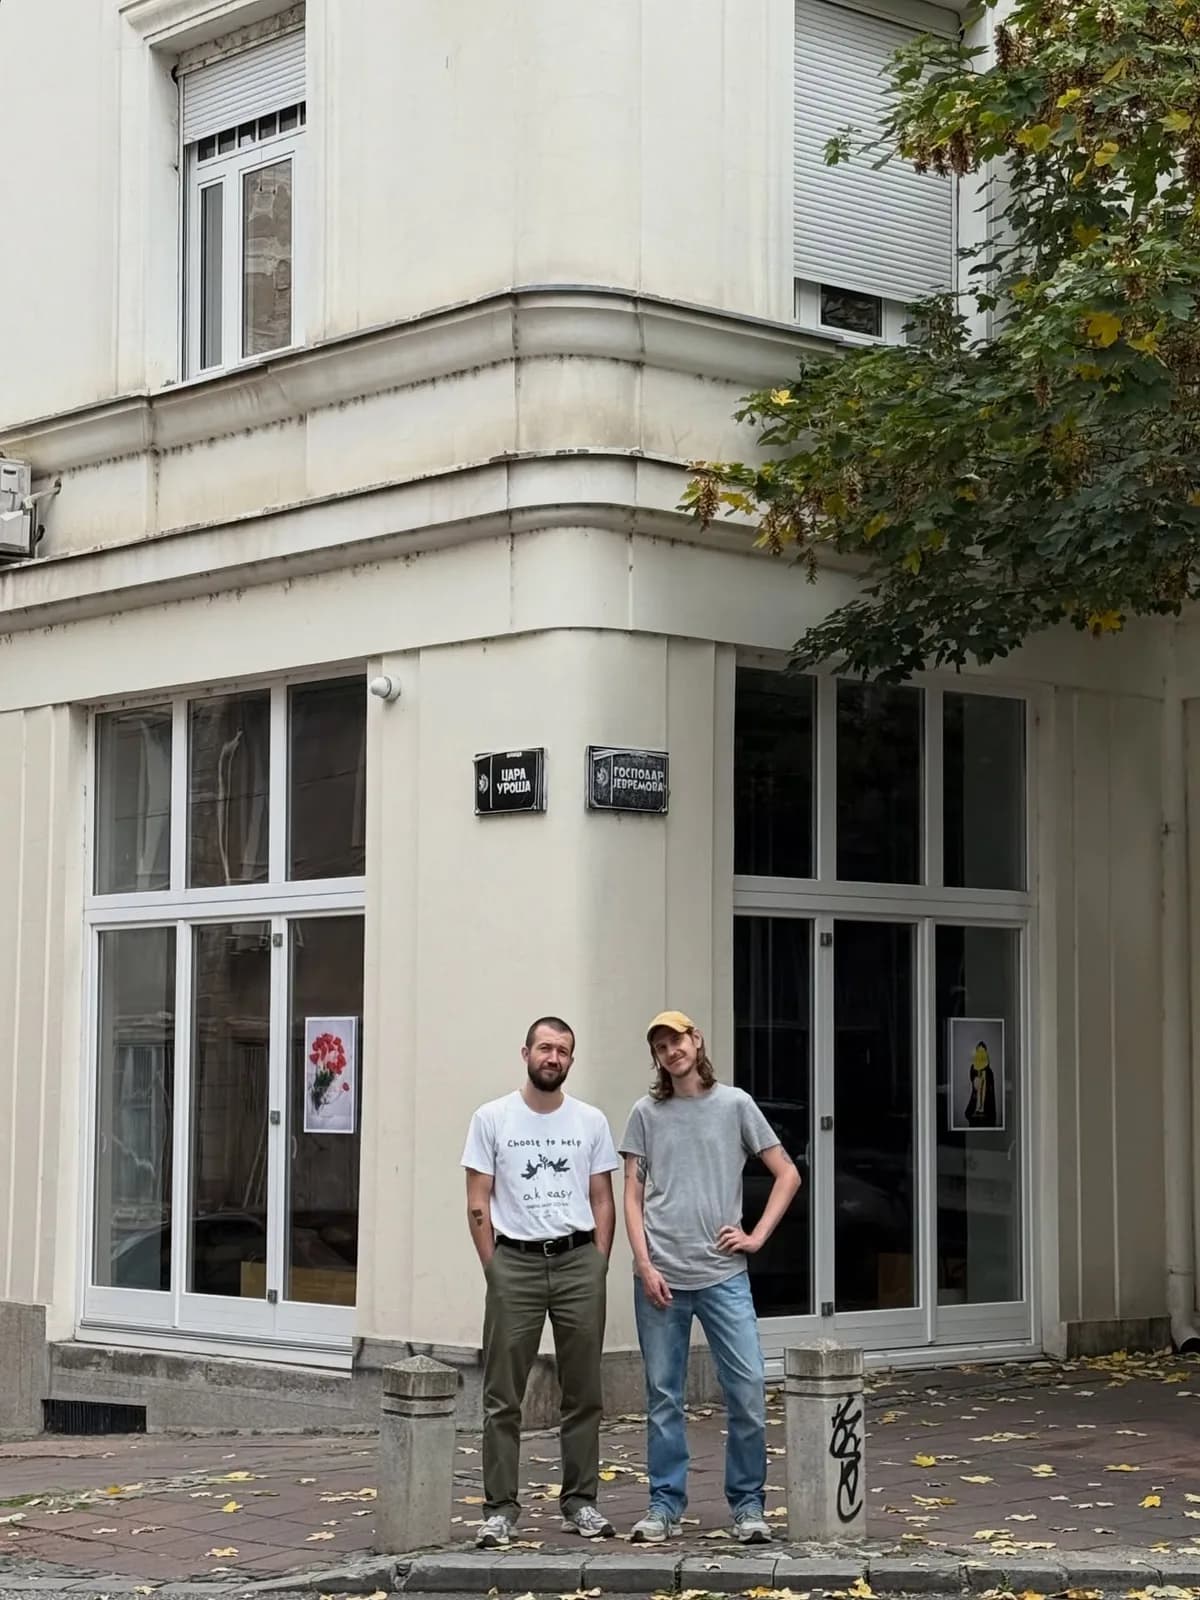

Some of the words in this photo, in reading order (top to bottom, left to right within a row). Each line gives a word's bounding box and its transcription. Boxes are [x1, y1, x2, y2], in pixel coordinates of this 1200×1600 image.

[501, 768, 526, 781] ЦАРА
[613, 766, 664, 781] ГОСПОДАР
[496, 781, 531, 794] УРОША
[613, 778, 664, 792] ЈЕВРЕМОВА
[507, 1139, 541, 1148] Choose
[546, 1138, 556, 1147] to
[561, 1138, 582, 1148] help
[547, 1189, 573, 1200] easy
